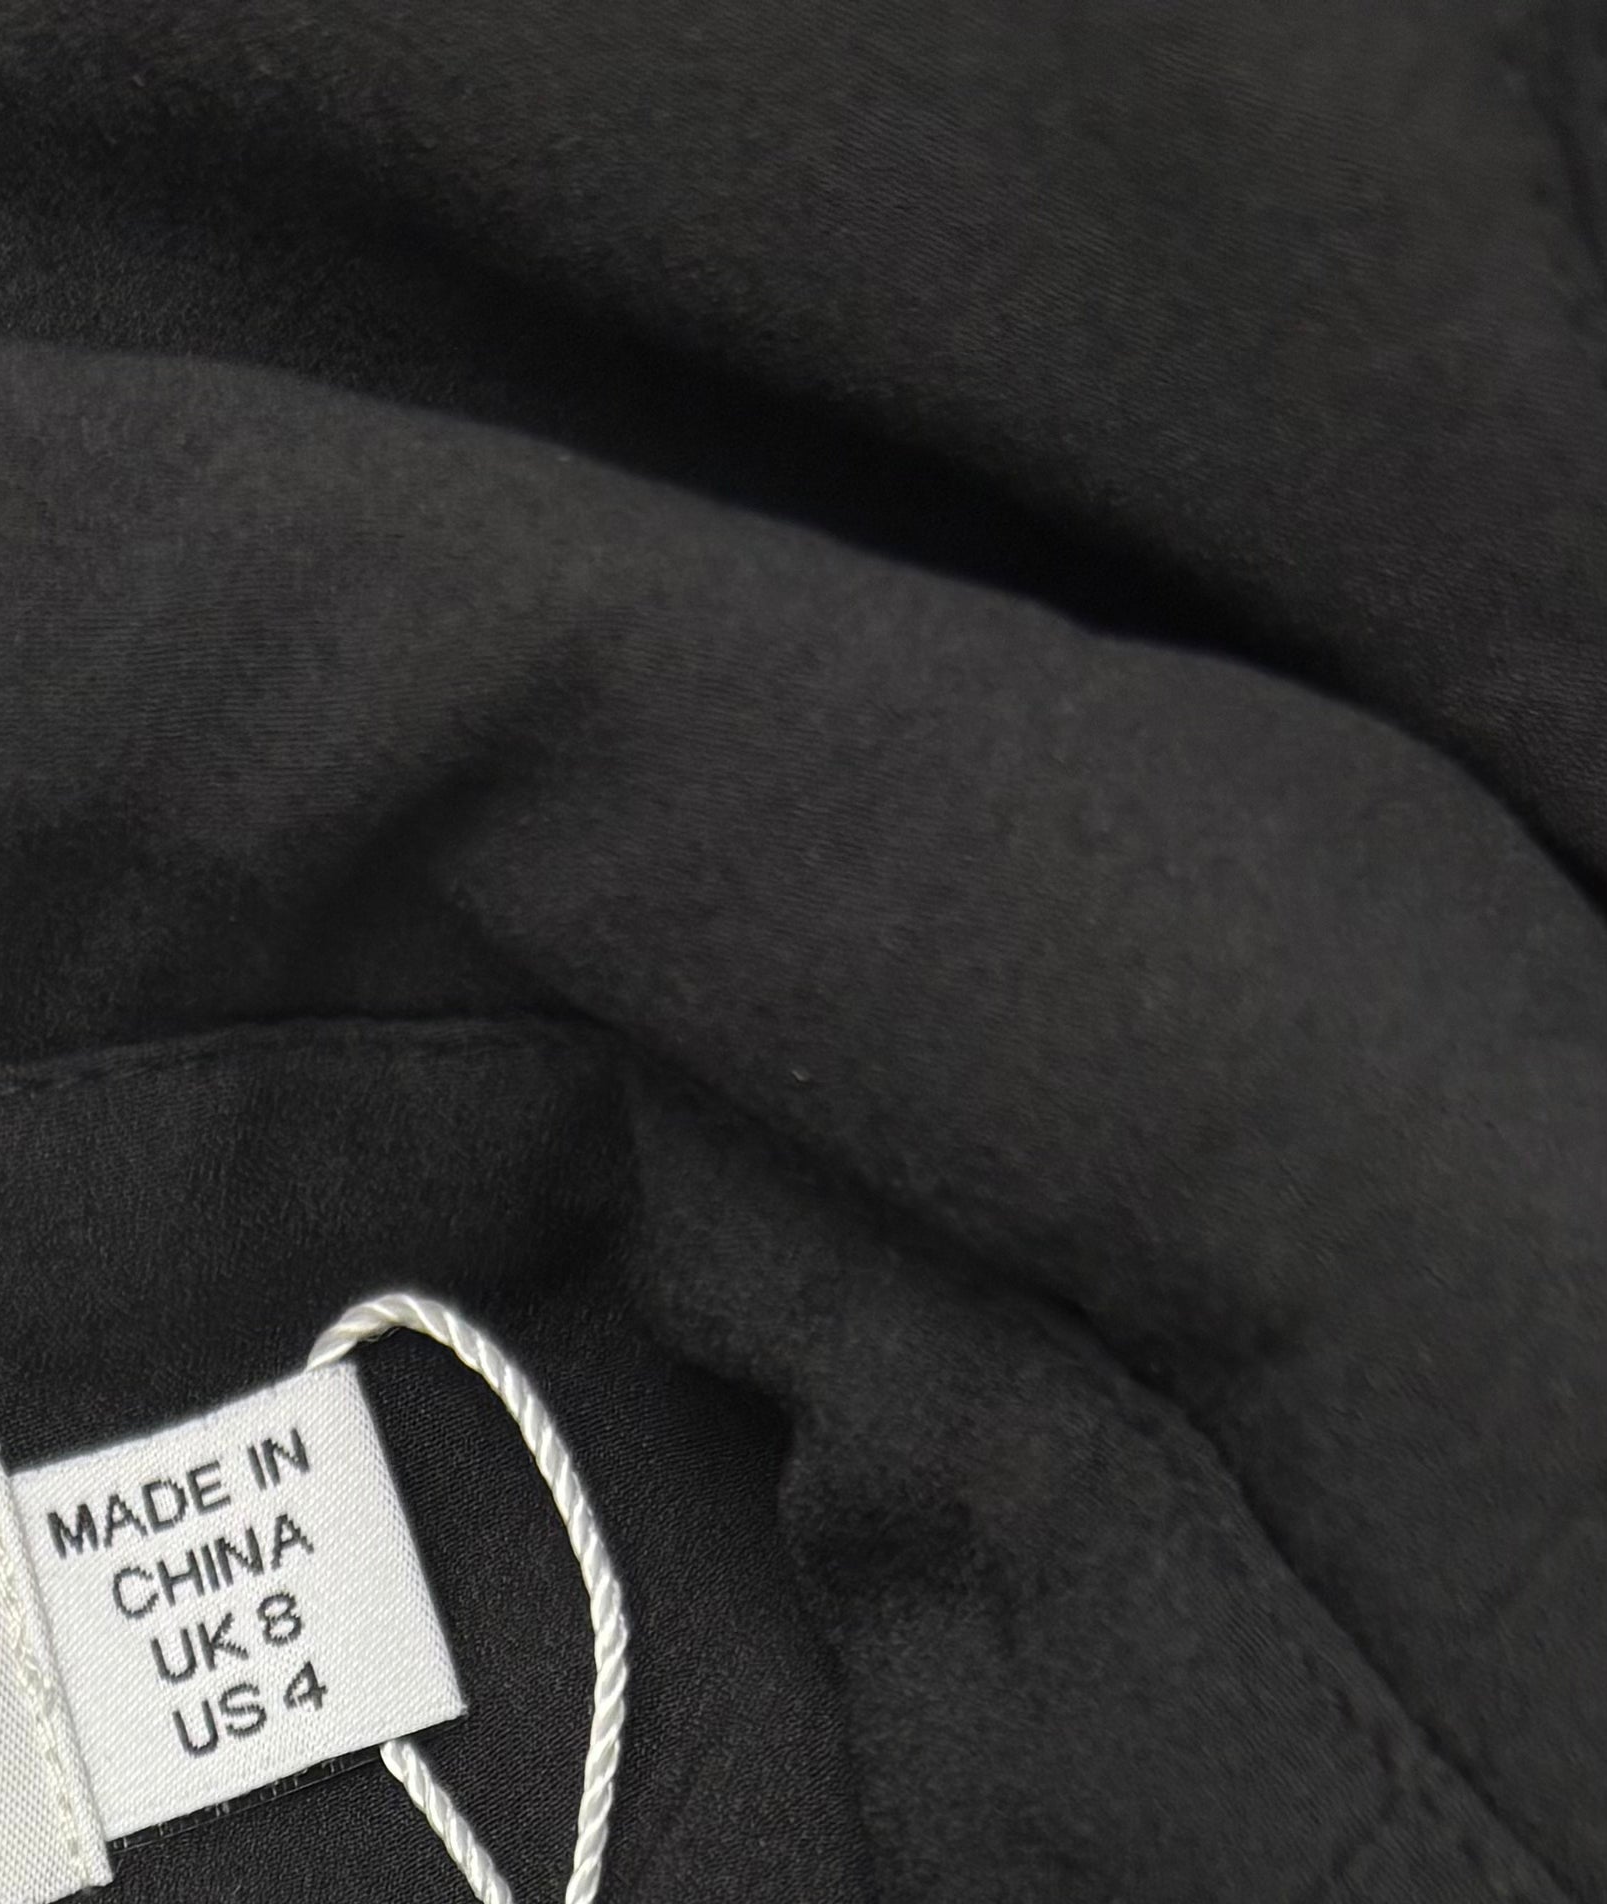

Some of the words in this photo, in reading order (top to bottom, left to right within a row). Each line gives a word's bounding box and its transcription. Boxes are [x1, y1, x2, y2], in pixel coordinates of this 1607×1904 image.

[47, 1461, 232, 1558] MADE
[248, 1427, 311, 1490] IN
[111, 1512, 313, 1618] CHINA
[150, 1613, 249, 1684] UK
[257, 1591, 304, 1645] 8
[172, 1682, 268, 1757] US
[283, 1661, 328, 1711] 4
